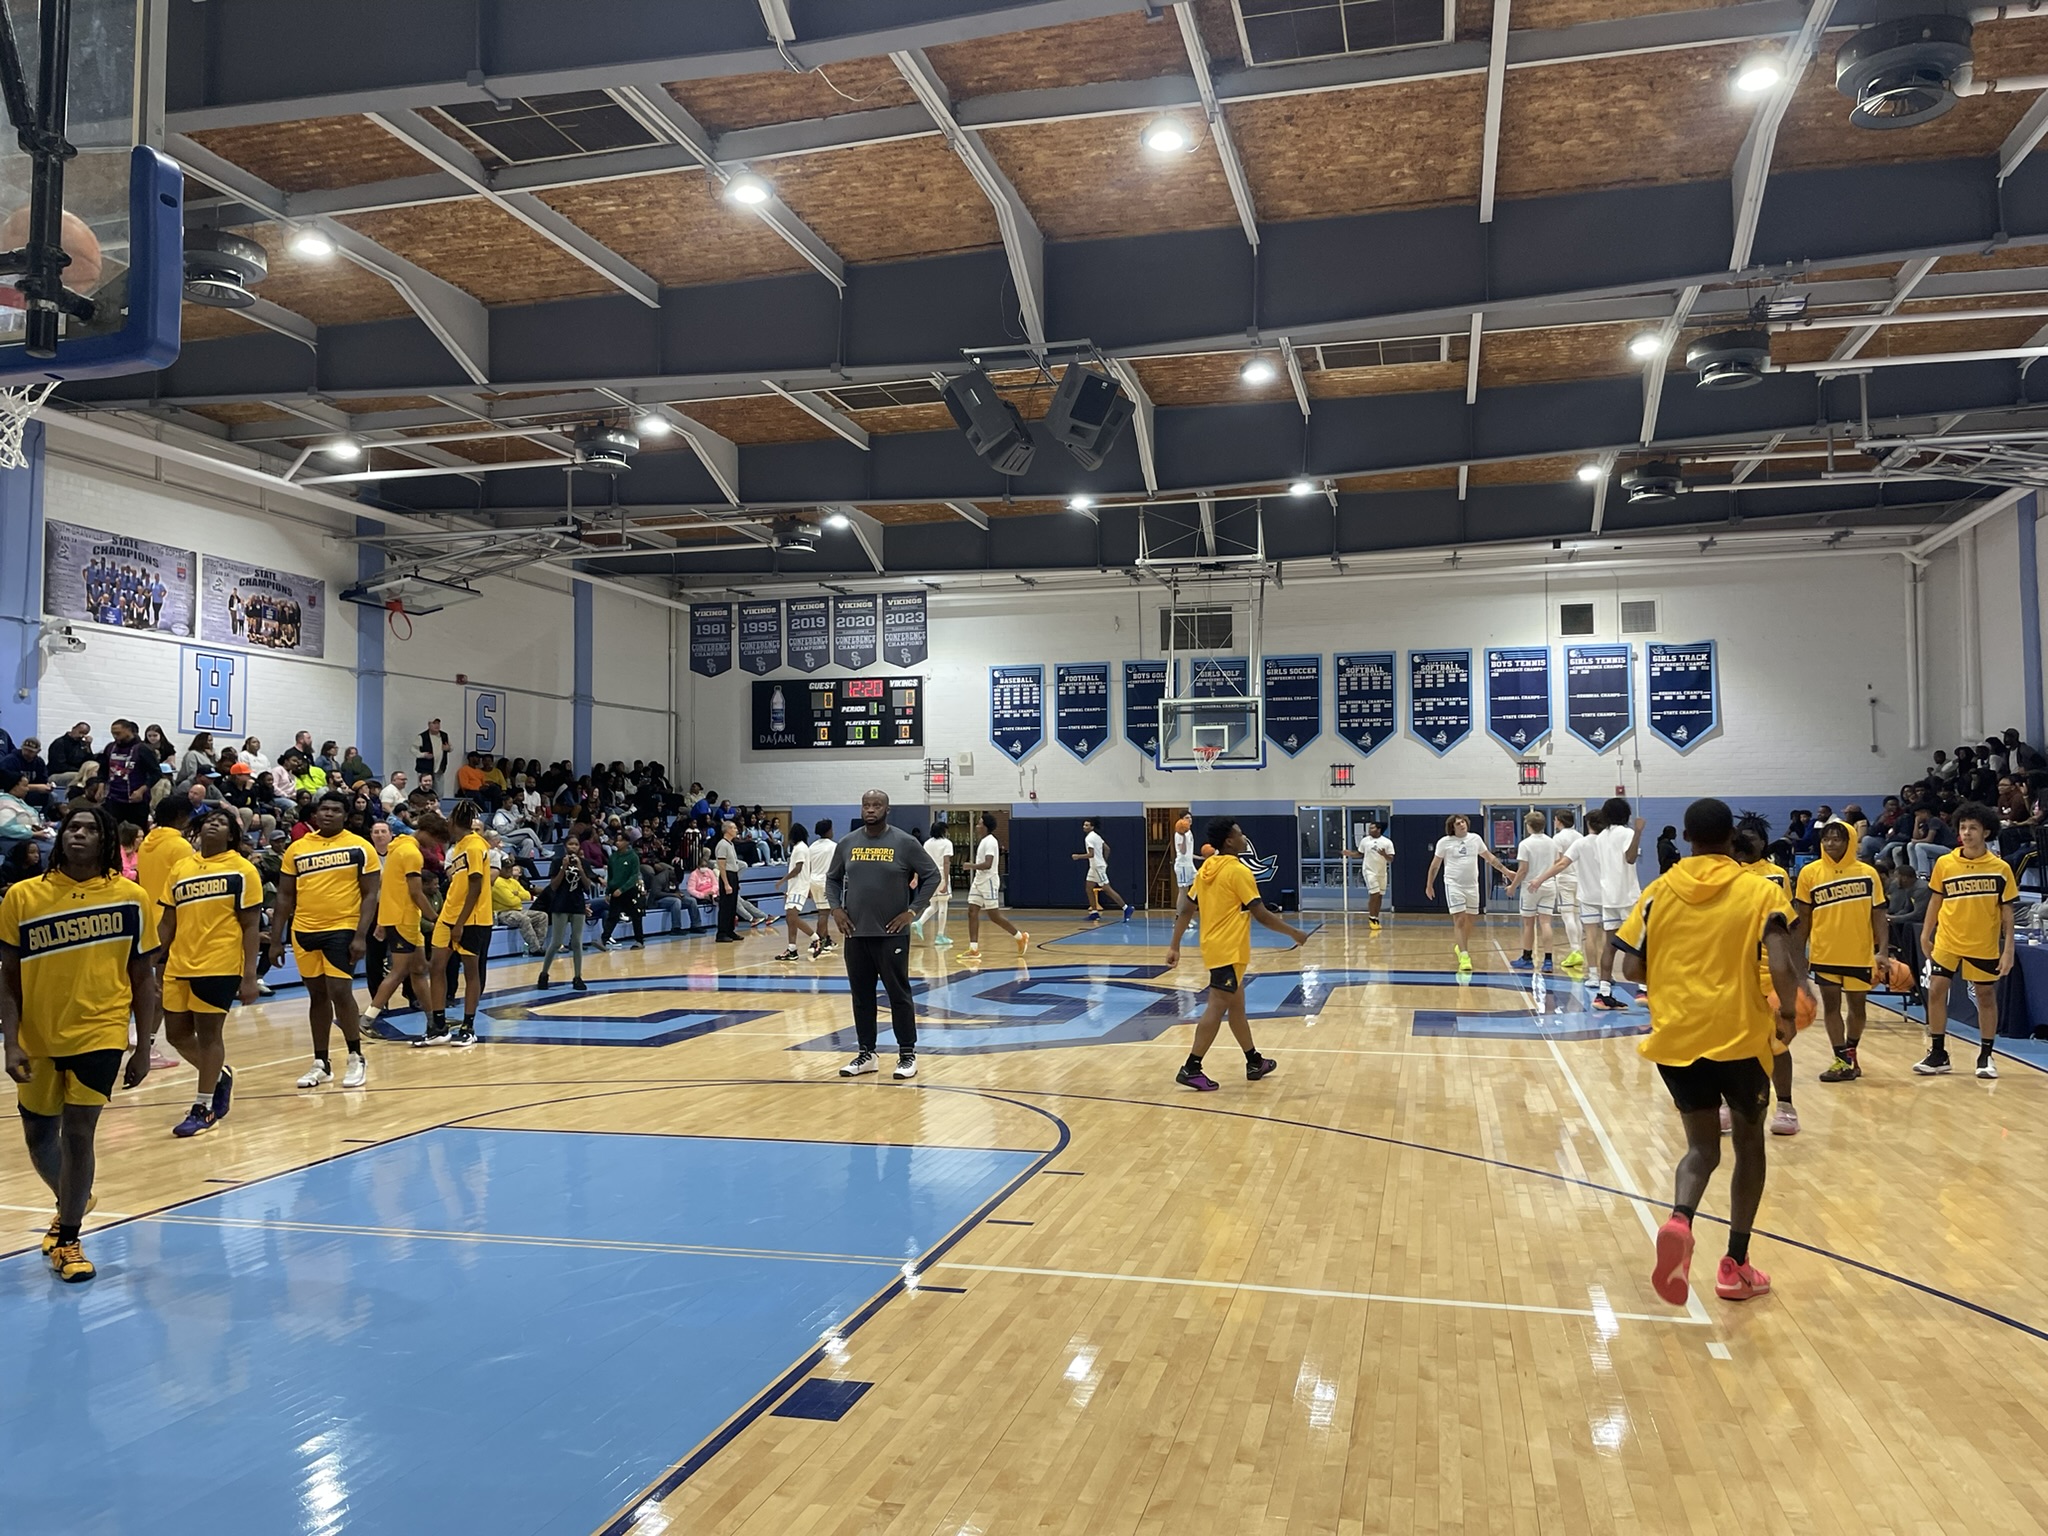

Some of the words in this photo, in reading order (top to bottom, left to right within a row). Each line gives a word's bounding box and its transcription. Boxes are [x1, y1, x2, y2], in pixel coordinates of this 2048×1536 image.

[111, 535, 140, 550] STATE
[92, 545, 160, 568] CHAMPIONS
[254, 569, 277, 581] STATE
[239, 578, 293, 597] CHAMPIONS
[790, 602, 825, 610] VIKINGS
[887, 598, 922, 606] VIKINGS
[694, 609, 728, 617] VIKINGS
[742, 607, 777, 615] VIKINGS
[791, 616, 826, 630] 2019
[836, 615, 875, 627] 2020
[885, 611, 925, 625] 2023
[696, 624, 727, 635] 1981
[743, 621, 777, 634] 1995
[788, 635, 829, 647] CONFERENCE
[835, 634, 876, 646] CONFERENCE
[884, 631, 926, 642] CONFERENCE
[692, 642, 730, 652] CONFERENCE
[740, 640, 780, 651] CONFERENCE
[887, 640, 923, 648] CHAMPIONS
[1420, 663, 1460, 671] SOFTBALL
[1491, 660, 1513, 668] BOYS
[1514, 659, 1546, 667] TENNIS
[1201, 670, 1221, 678] GIRLS
[1346, 666, 1384, 674] SOFTBALL
[808, 682, 836, 690] GUEST
[849, 679, 883, 698] 12:20
[889, 679, 918, 688] VIKINGS
[194, 653, 234, 732] H
[475, 693, 497, 752] S
[759, 732, 796, 745] DASANI
[851, 847, 895, 856] GOLDSBORO
[850, 853, 893, 862] ATHLETICS
[175, 878, 227, 901] OLDSBORO
[1814, 882, 1867, 905] GOLDSBORO
[28, 911, 123, 951] GOLDSBORO
